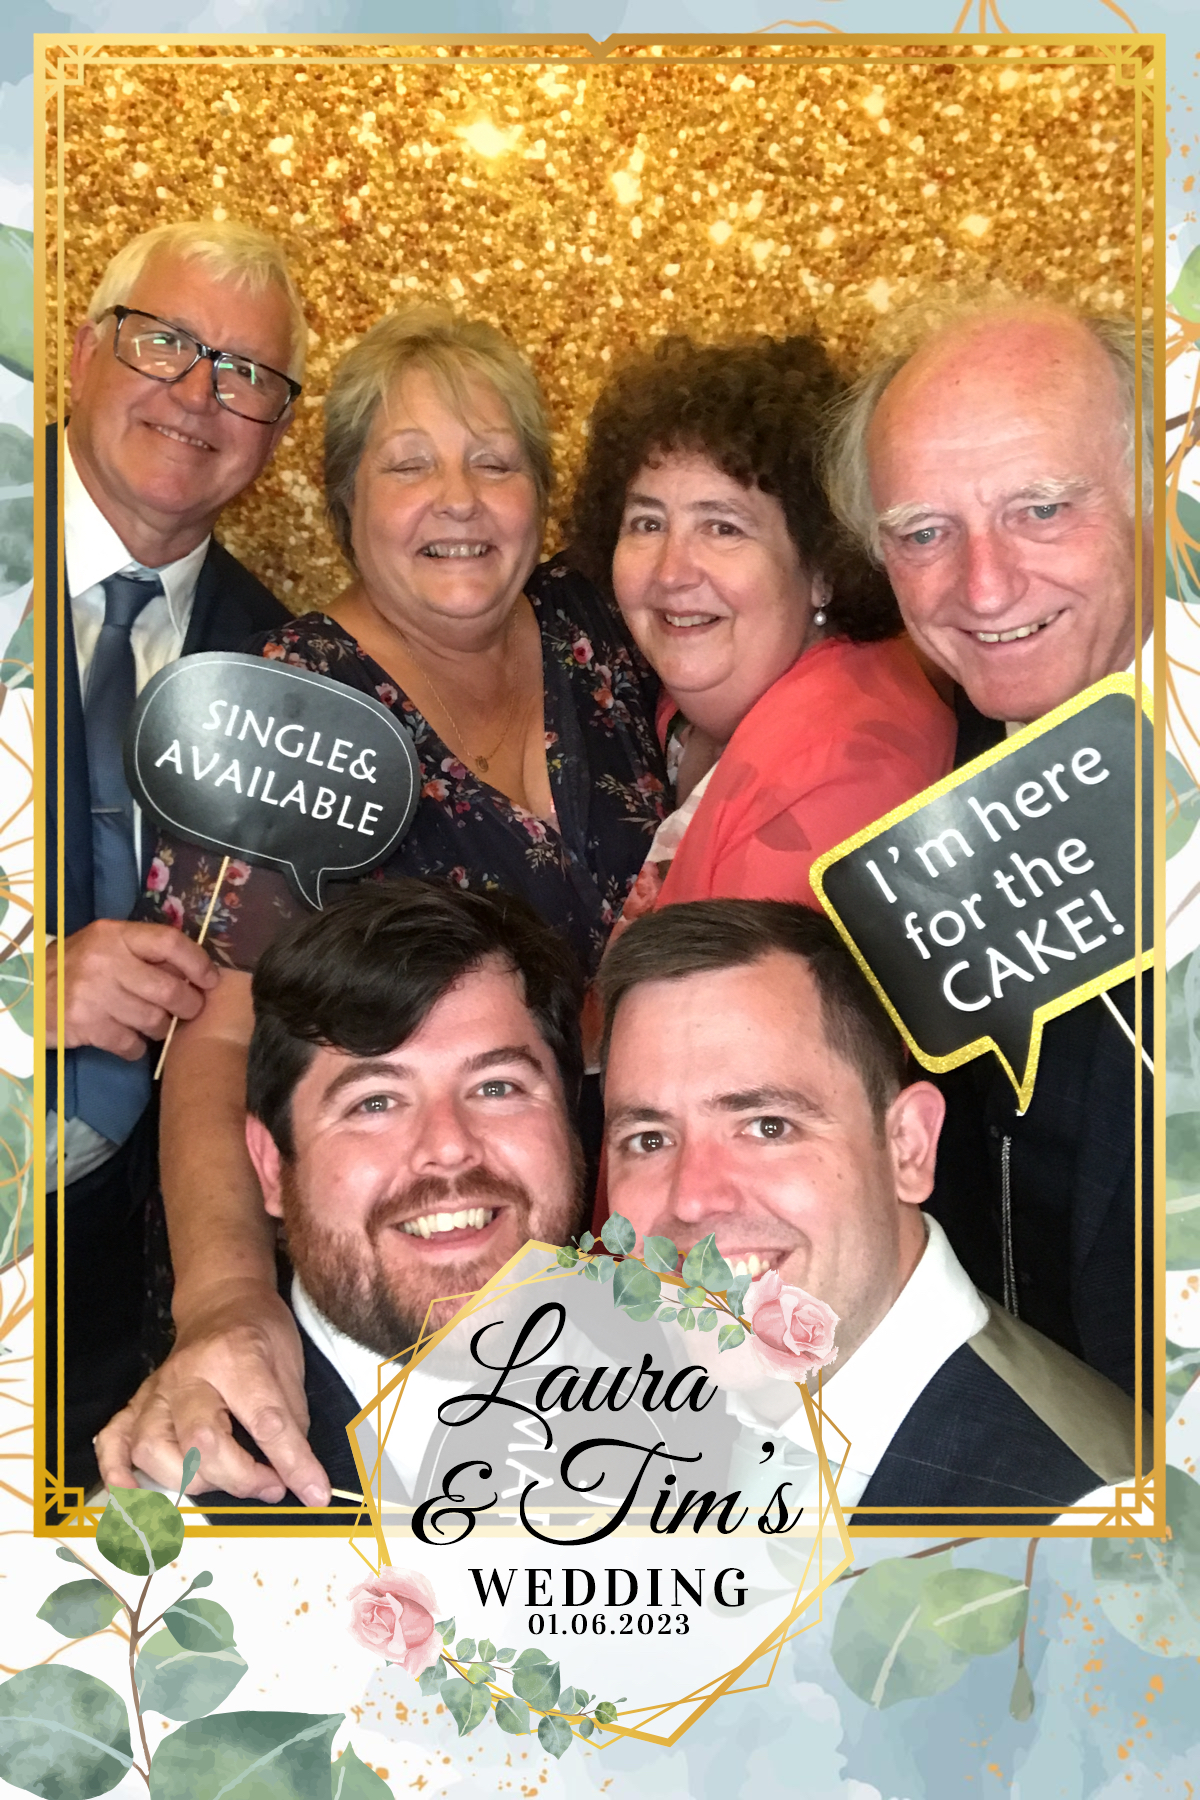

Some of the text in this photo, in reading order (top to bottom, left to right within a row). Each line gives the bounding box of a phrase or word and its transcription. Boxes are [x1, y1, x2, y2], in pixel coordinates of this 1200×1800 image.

[154, 739, 383, 836] AVAILABLE
[865, 747, 1110, 904] I'm here
[904, 838, 1095, 960] for the
[943, 889, 1125, 1012] CAKE!
